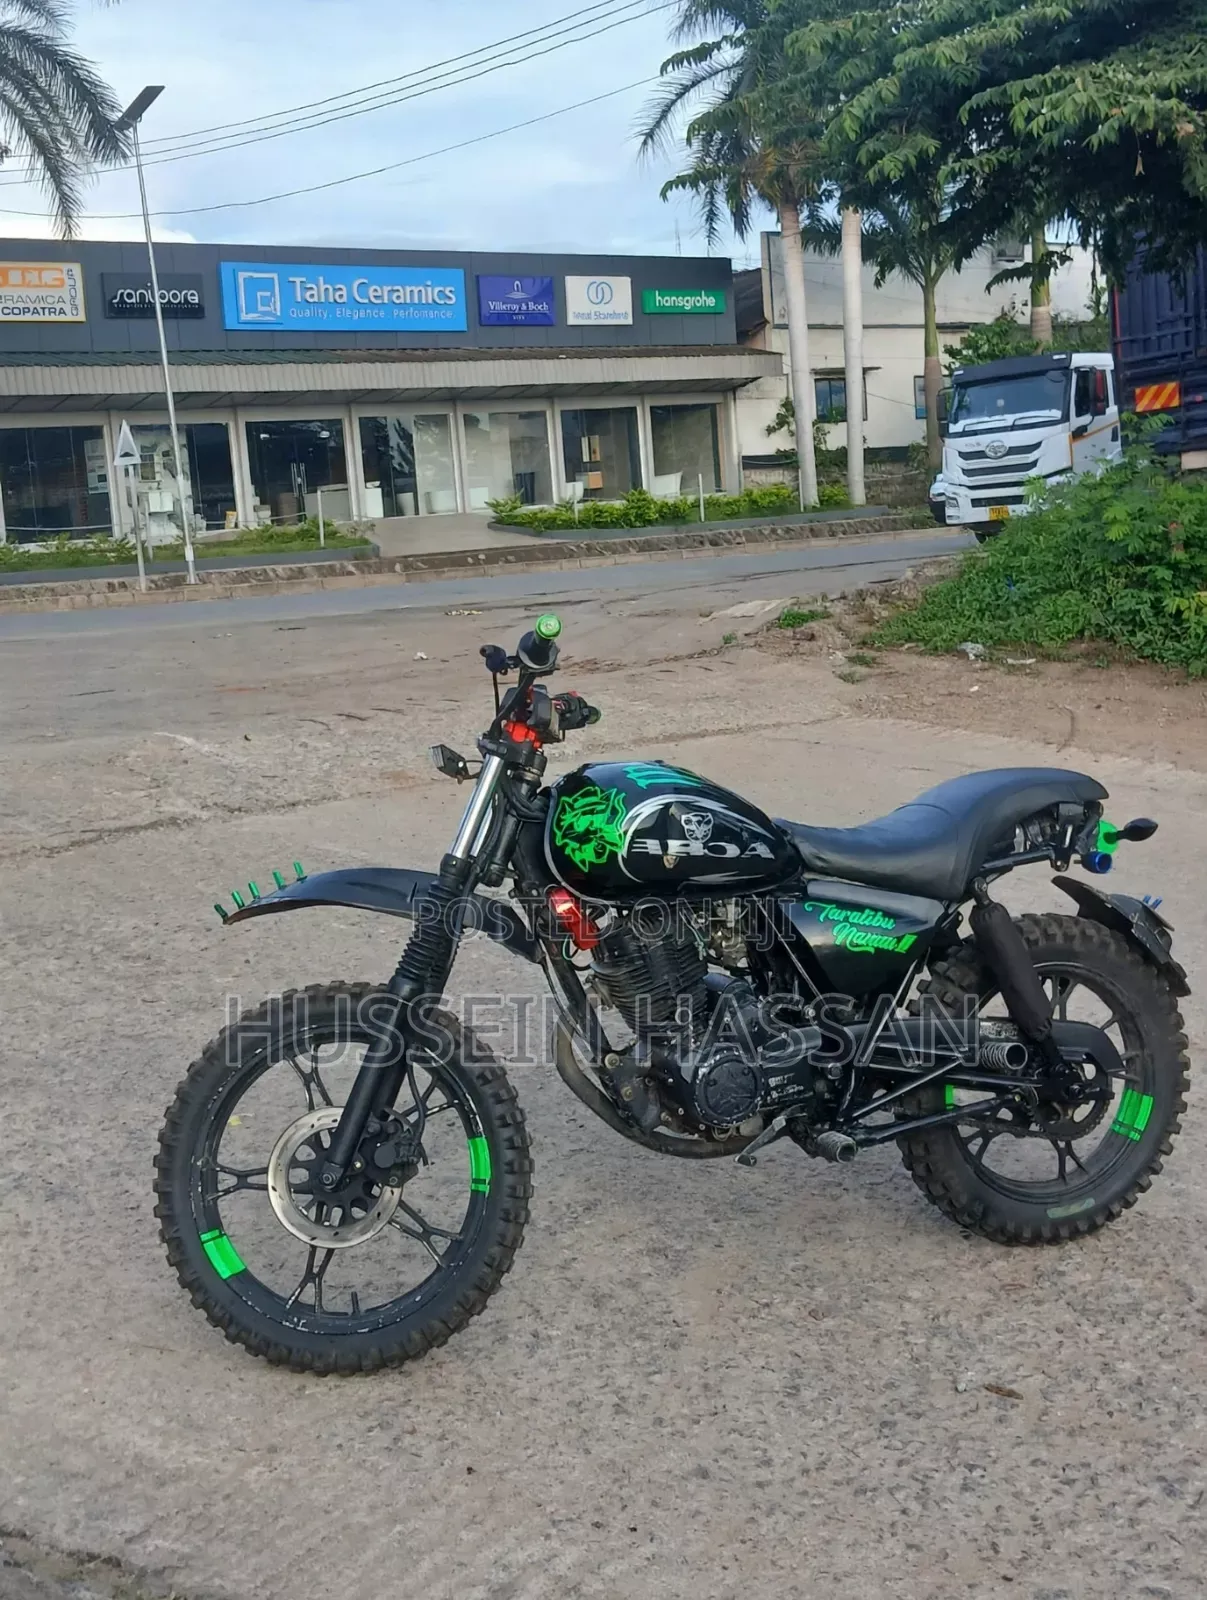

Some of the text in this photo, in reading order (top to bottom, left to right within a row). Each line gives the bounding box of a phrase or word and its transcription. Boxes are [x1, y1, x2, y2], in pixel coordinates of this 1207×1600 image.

[288, 277, 456, 305] Taha Ceramics
[0, 294, 67, 305] RAMICA
[488, 301, 549, 313] Villeroy & Boch
[655, 290, 716, 310] hansgrohe
